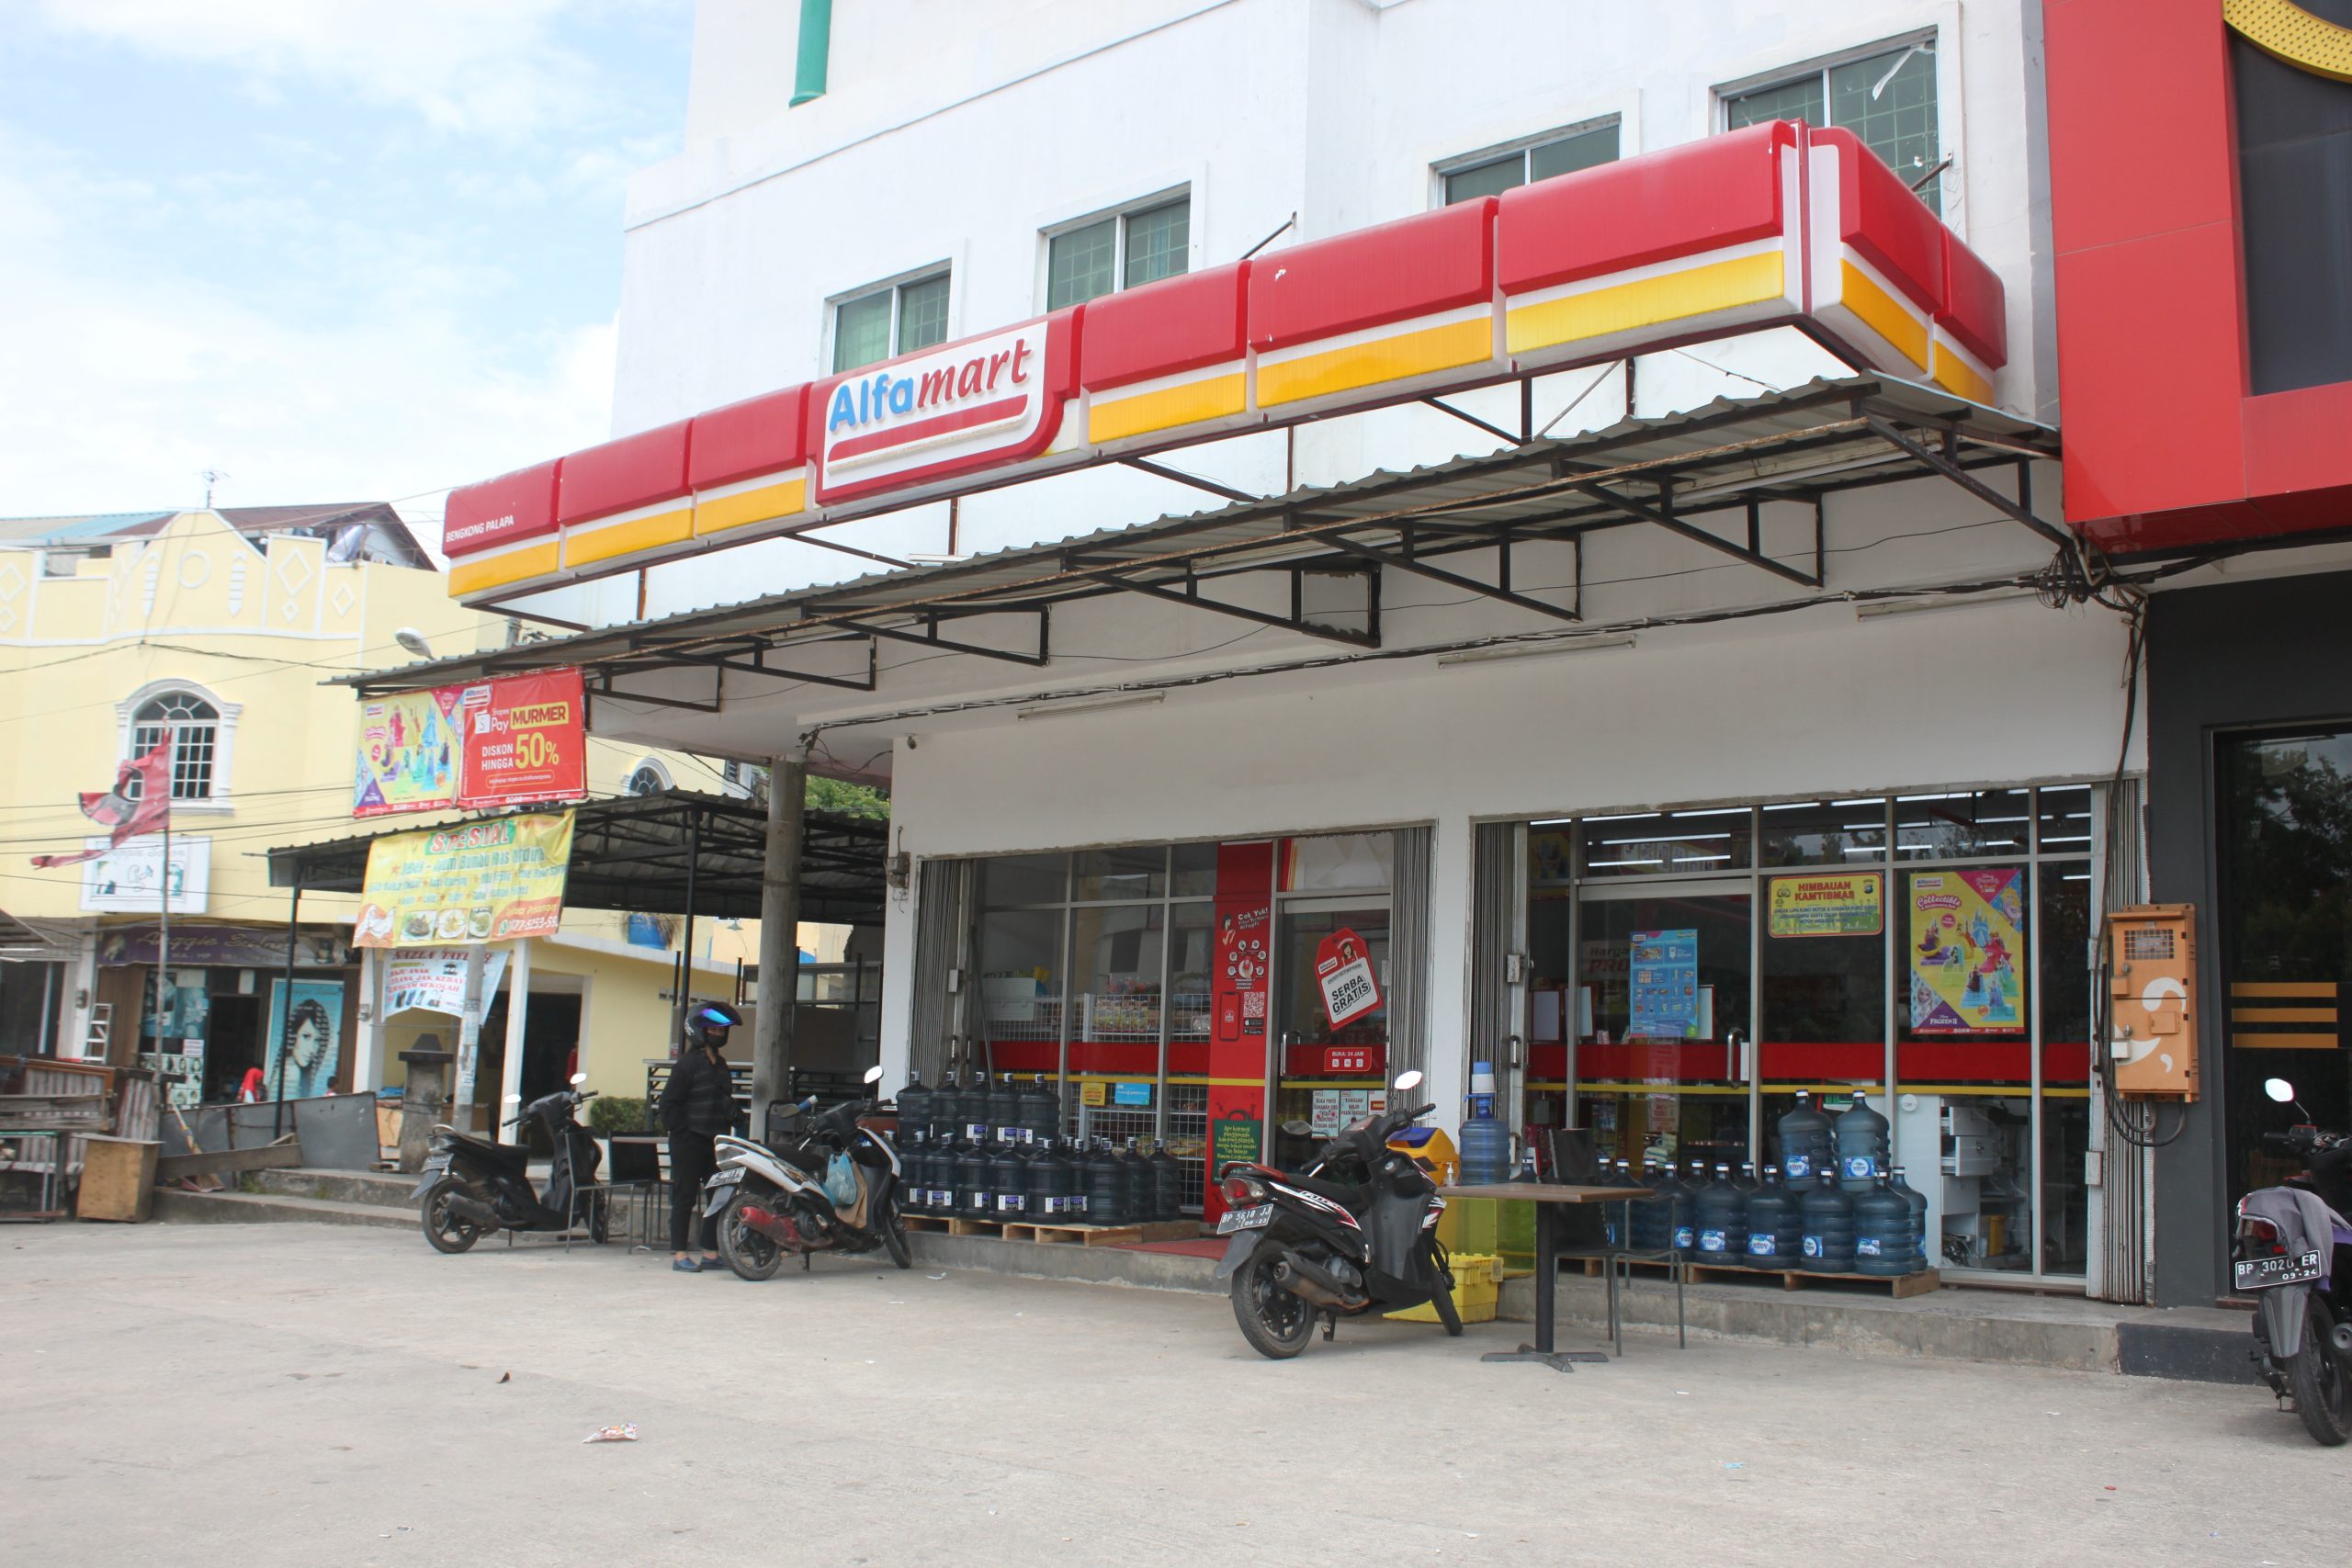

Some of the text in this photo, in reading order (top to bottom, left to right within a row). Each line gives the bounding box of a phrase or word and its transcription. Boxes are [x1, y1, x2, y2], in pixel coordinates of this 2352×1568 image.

[828, 338, 1032, 433] Alfamart
[446, 514, 514, 543] BENGKONG PALAPA
[492, 717, 509, 735] Pay
[512, 705, 567, 726] MURMER
[481, 732, 560, 769] DISKON 50%
[481, 758, 514, 771] HINGGA
[430, 821, 510, 853] SPESIAL
[1794, 890, 1855, 901] KAMTIBMAS
[1798, 881, 1851, 891] HIMBAUAN
[137, 931, 218, 951] Aggie
[1332, 975, 1364, 1000] SERBA
[1332, 982, 1369, 1013] GRATIS
[1222, 1213, 1233, 1224] BP
[2238, 1263, 2254, 1275] BP
[2301, 1253, 2317, 1267] ER
